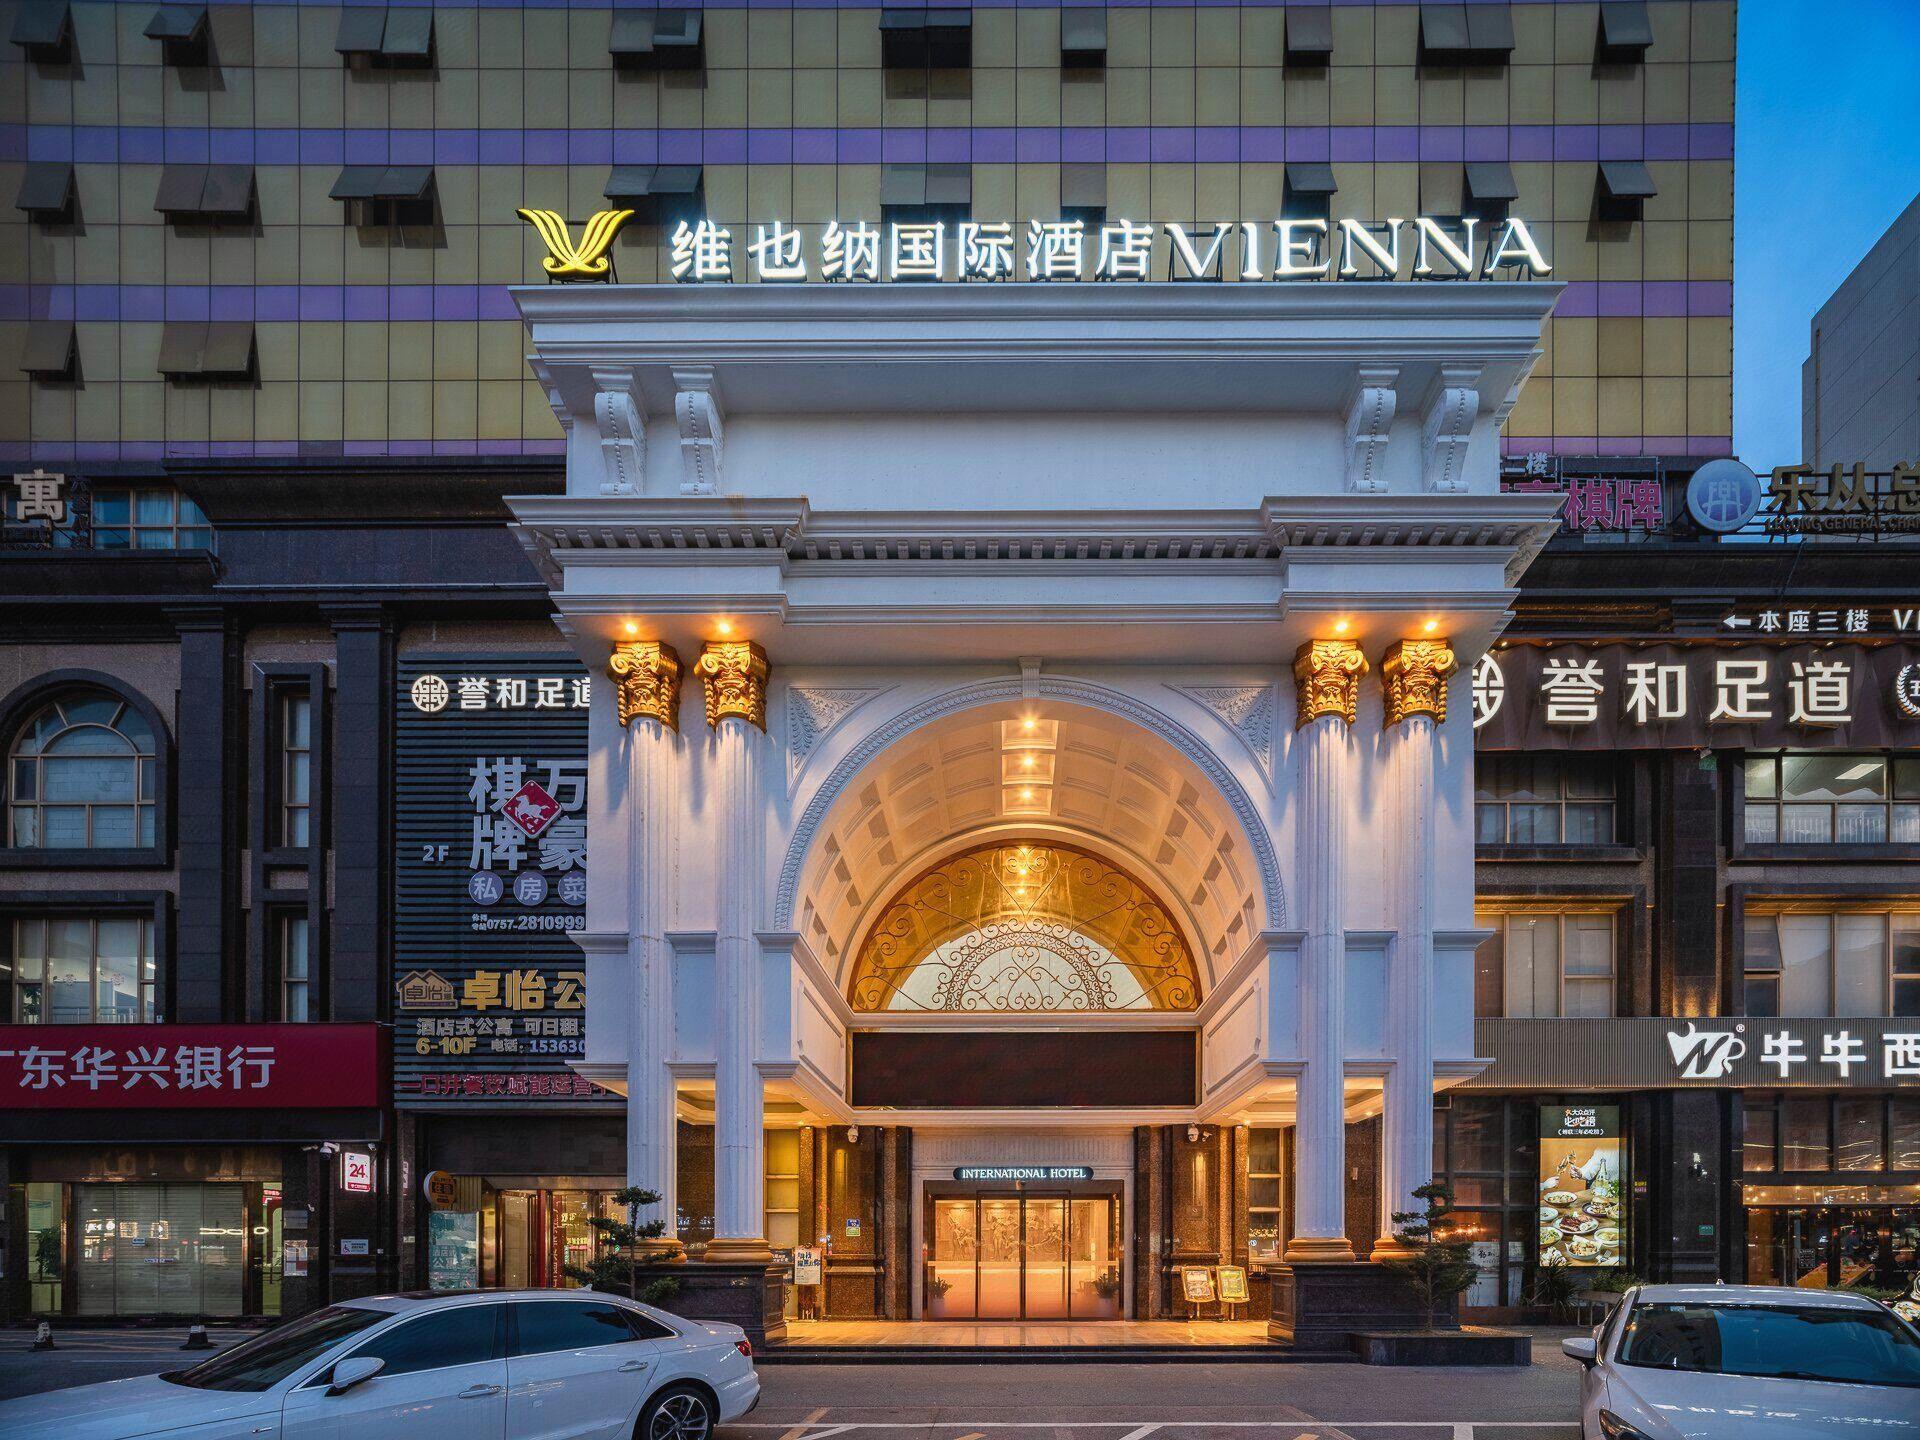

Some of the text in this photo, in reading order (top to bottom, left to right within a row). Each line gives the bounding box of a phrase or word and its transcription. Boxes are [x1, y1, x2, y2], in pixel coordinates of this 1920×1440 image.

[671, 217, 1553, 281] 维也纳国际酒店 VIENNA
[1500, 479, 1664, 530] 棋牌
[1823, 516, 1884, 532] GENERAL
[1758, 609, 1870, 632] 本座三楼
[1541, 658, 1852, 723] 誉和足道
[422, 844, 450, 862] 2F
[473, 877, 586, 901] 私房菜
[460, 969, 586, 1011] 卓怡公
[415, 1017, 514, 1037] 酒店式公寓
[415, 1036, 477, 1055] 6-10F
[1760, 1030, 1920, 1078] 牛牛西
[0, 1045, 276, 1091] 东华兴银行
[349, 1163, 366, 1179] 24
[962, 1169, 1087, 1179] INTERNATIONAL HOTEL
